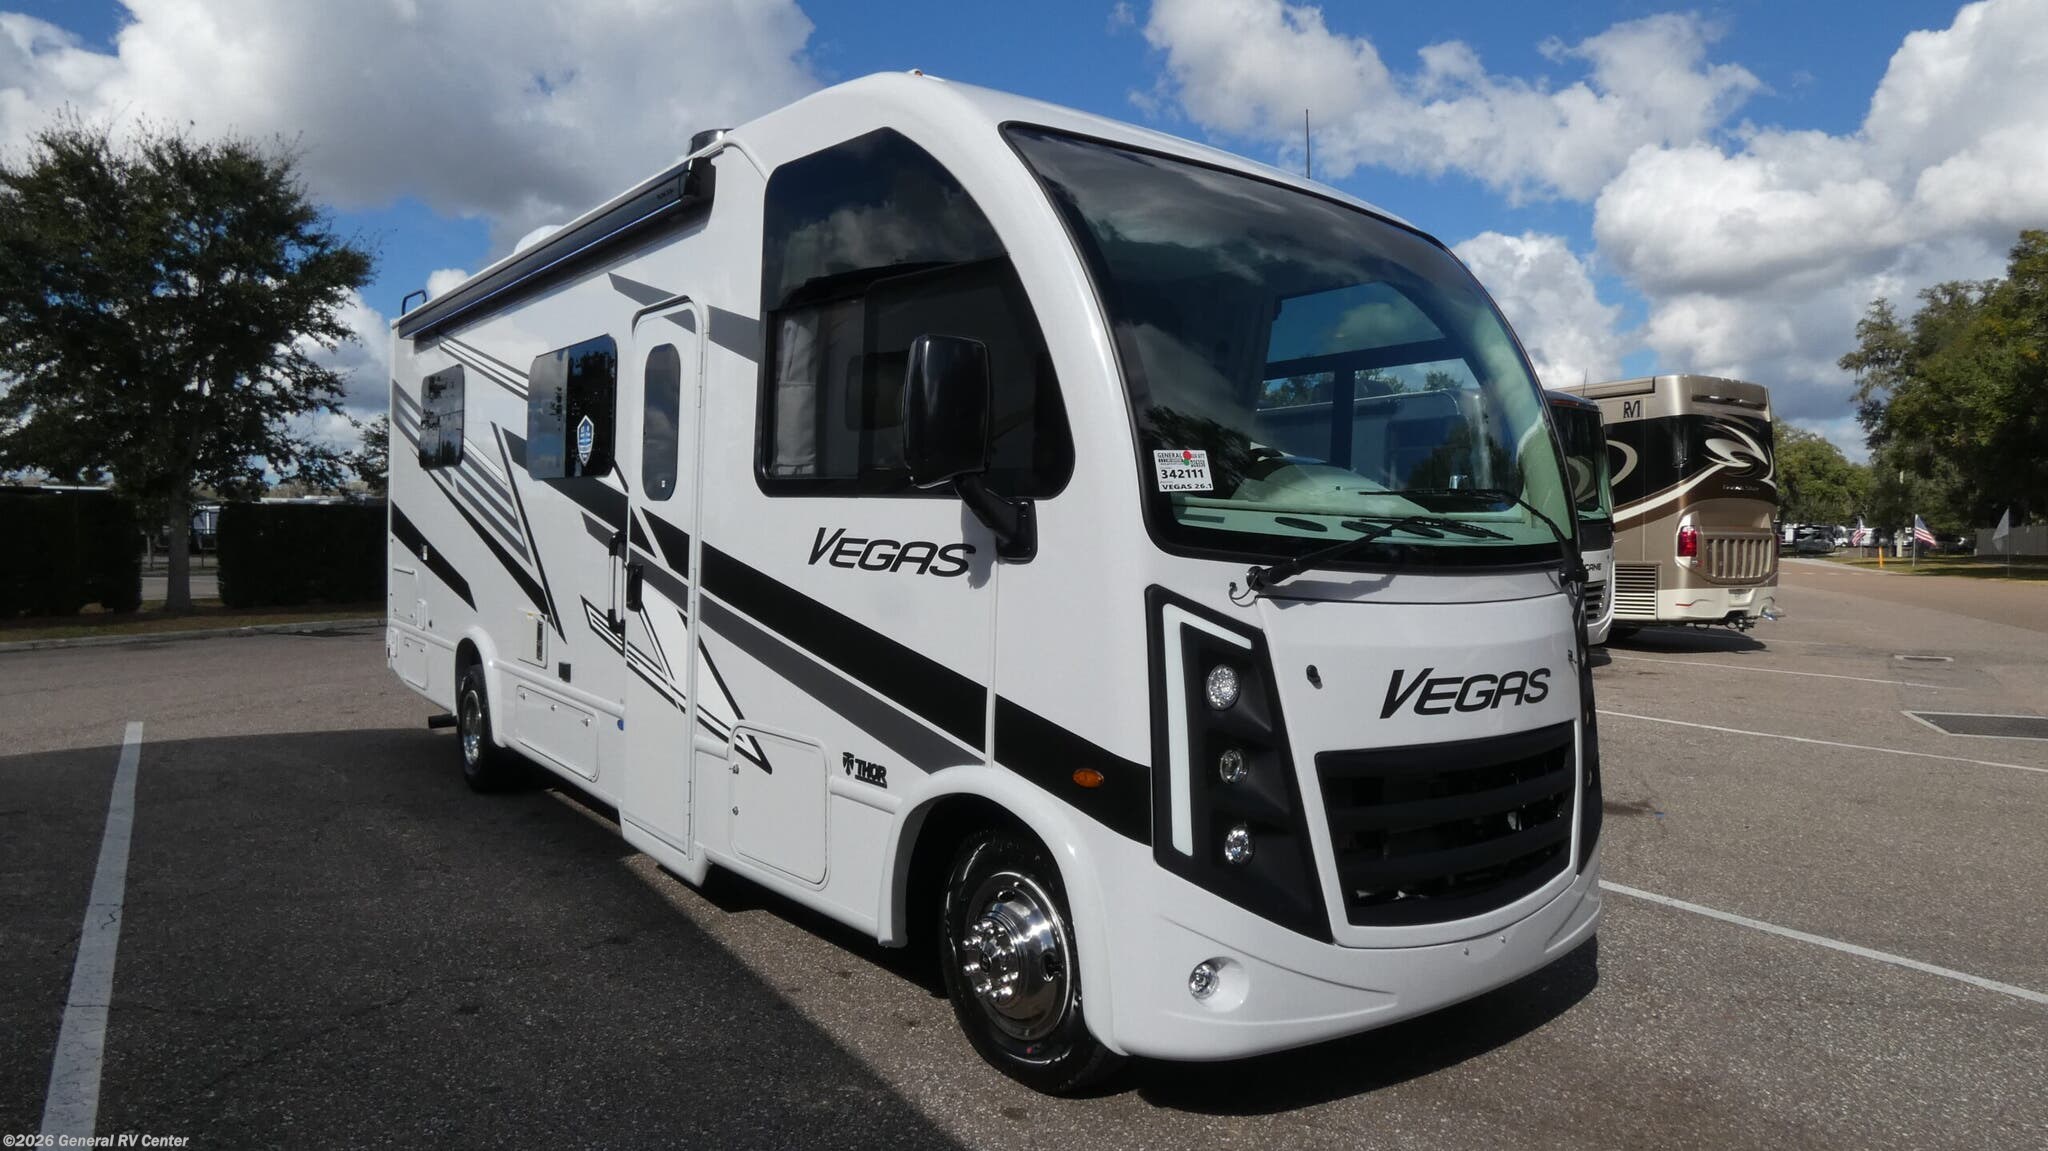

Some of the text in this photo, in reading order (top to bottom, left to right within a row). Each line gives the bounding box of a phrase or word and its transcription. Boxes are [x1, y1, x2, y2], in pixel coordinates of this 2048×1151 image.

[1161, 469, 1204, 479] 342111
[808, 527, 977, 577] VEGAS
[1379, 667, 1551, 719] VEGAS
[855, 758, 887, 784] THOR
